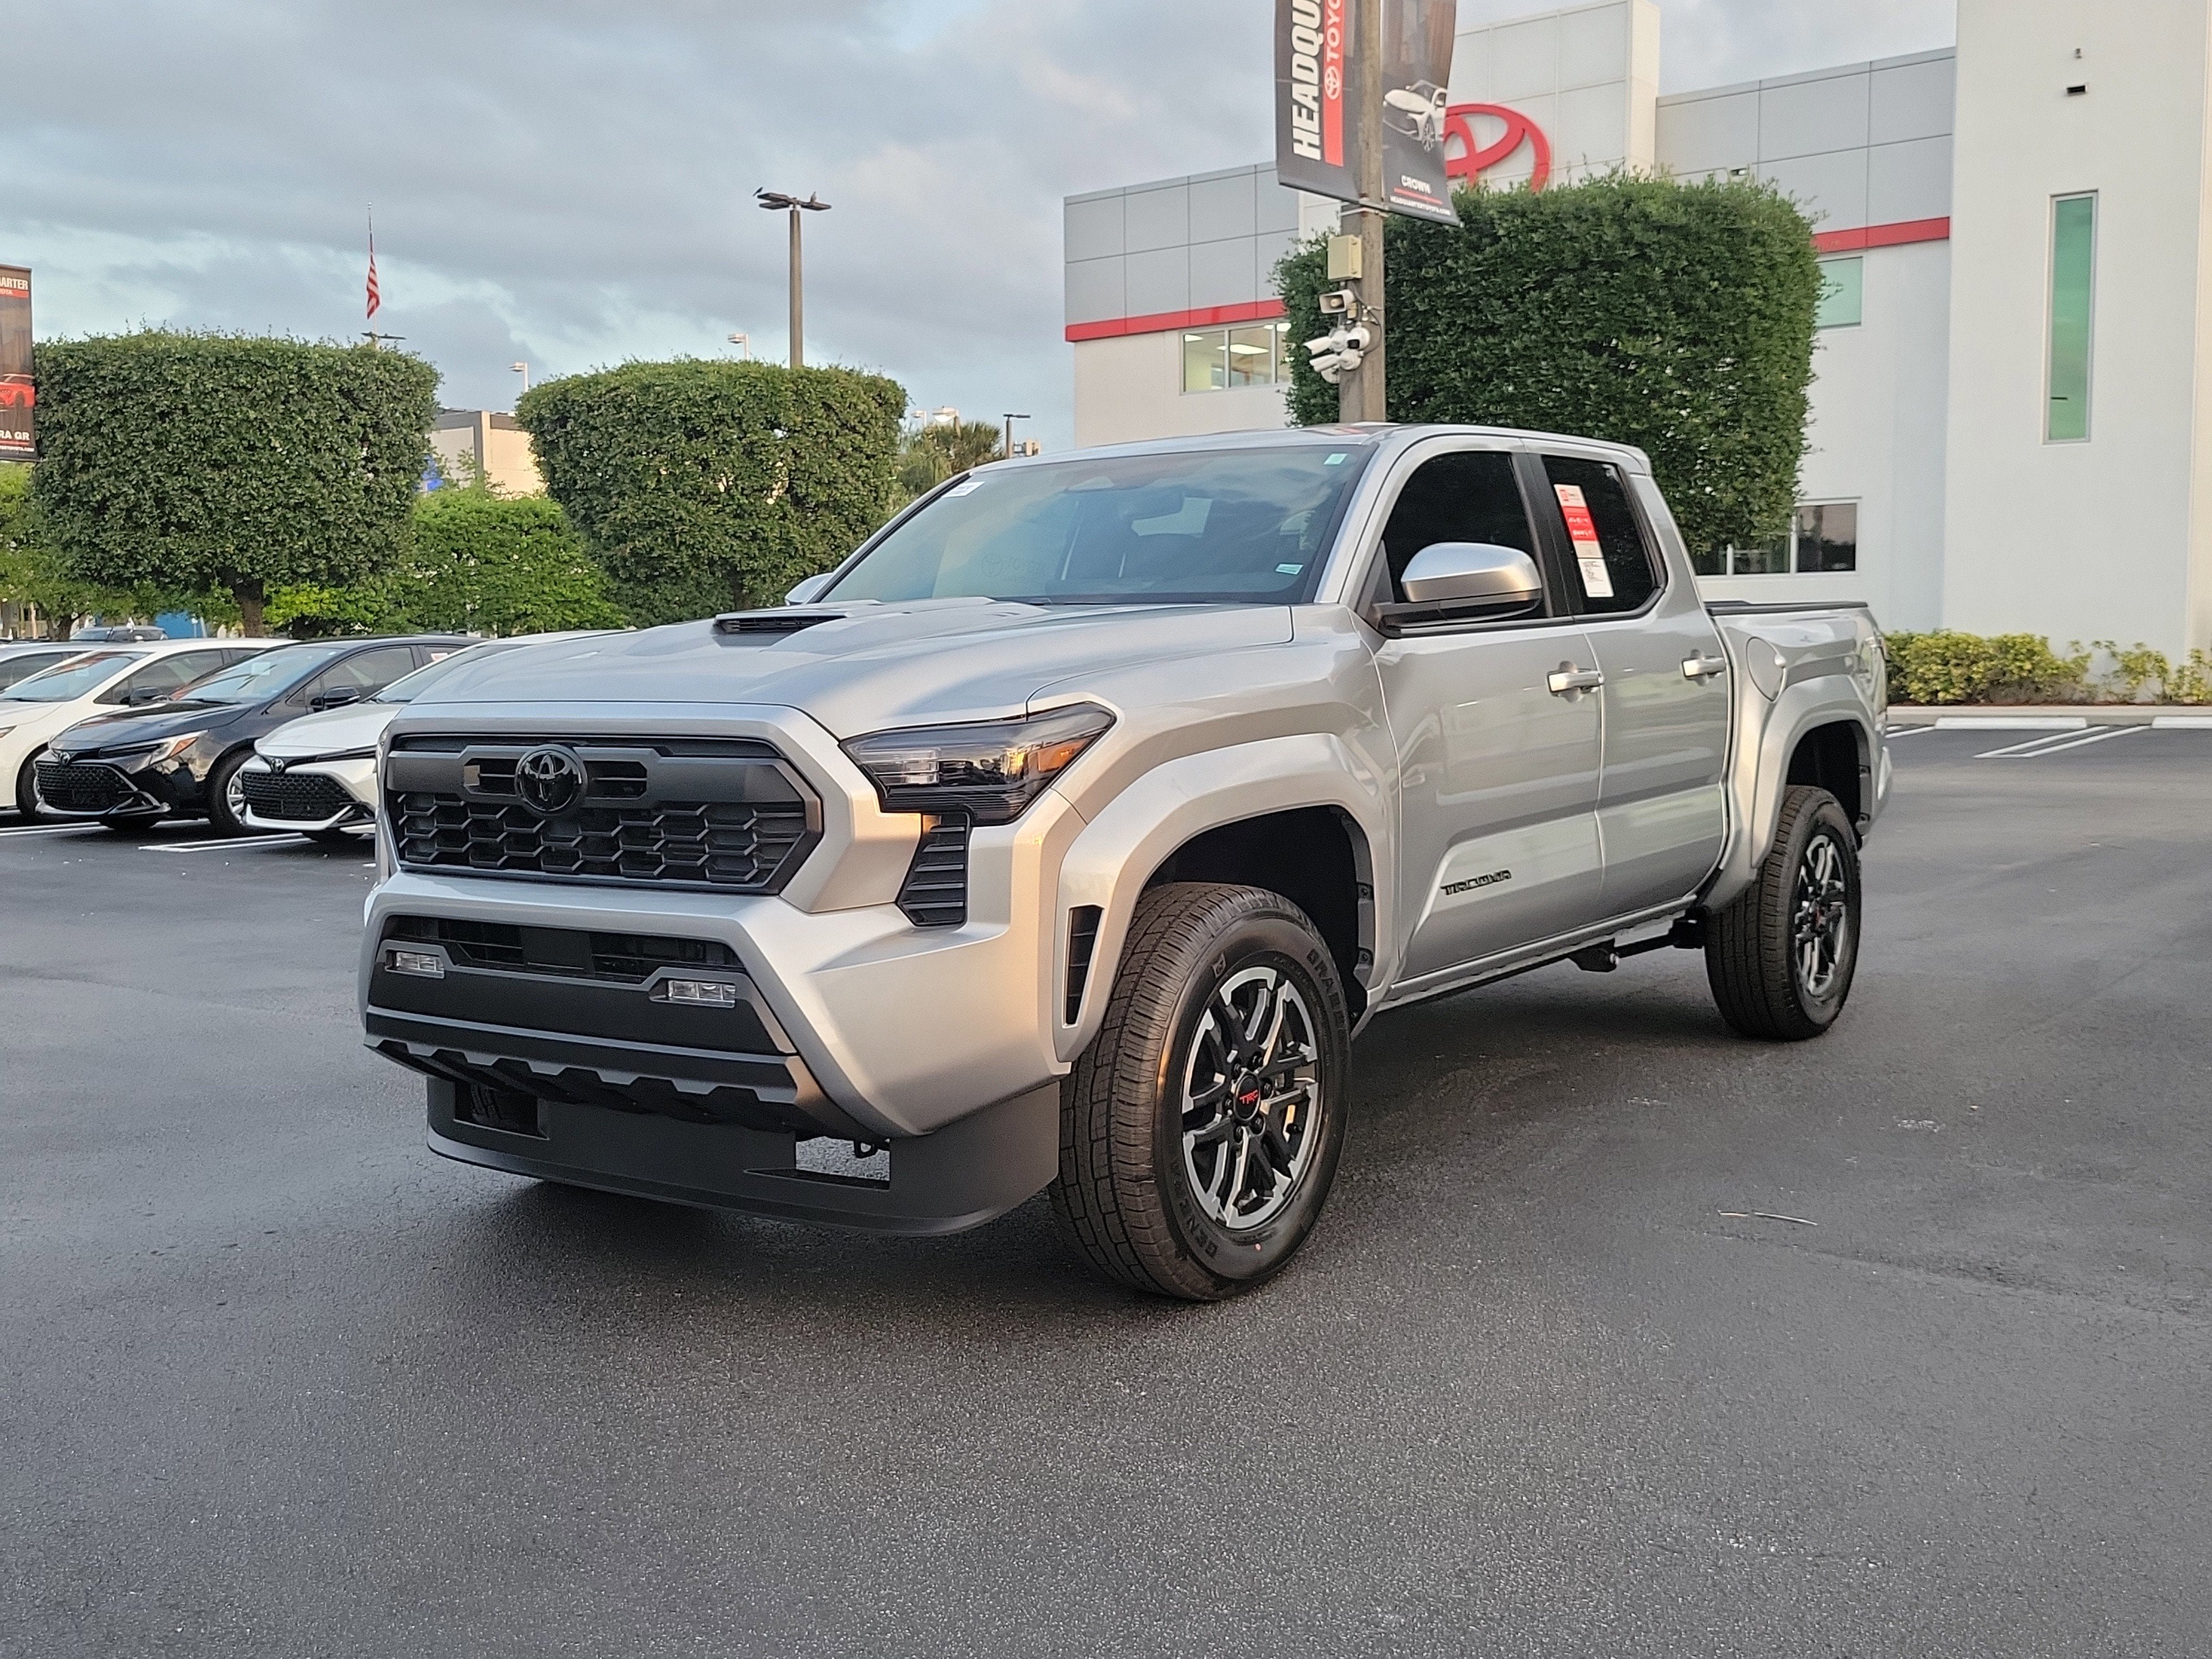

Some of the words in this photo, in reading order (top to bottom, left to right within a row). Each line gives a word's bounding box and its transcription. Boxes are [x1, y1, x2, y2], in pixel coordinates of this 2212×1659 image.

[1291, 0, 1324, 161] HEADQU
[1401, 174, 1432, 194] CROWN
[0, 276, 29, 290] ARTER
[14, 431, 30, 441] GR
[1440, 868, 1513, 895] TACOMA
